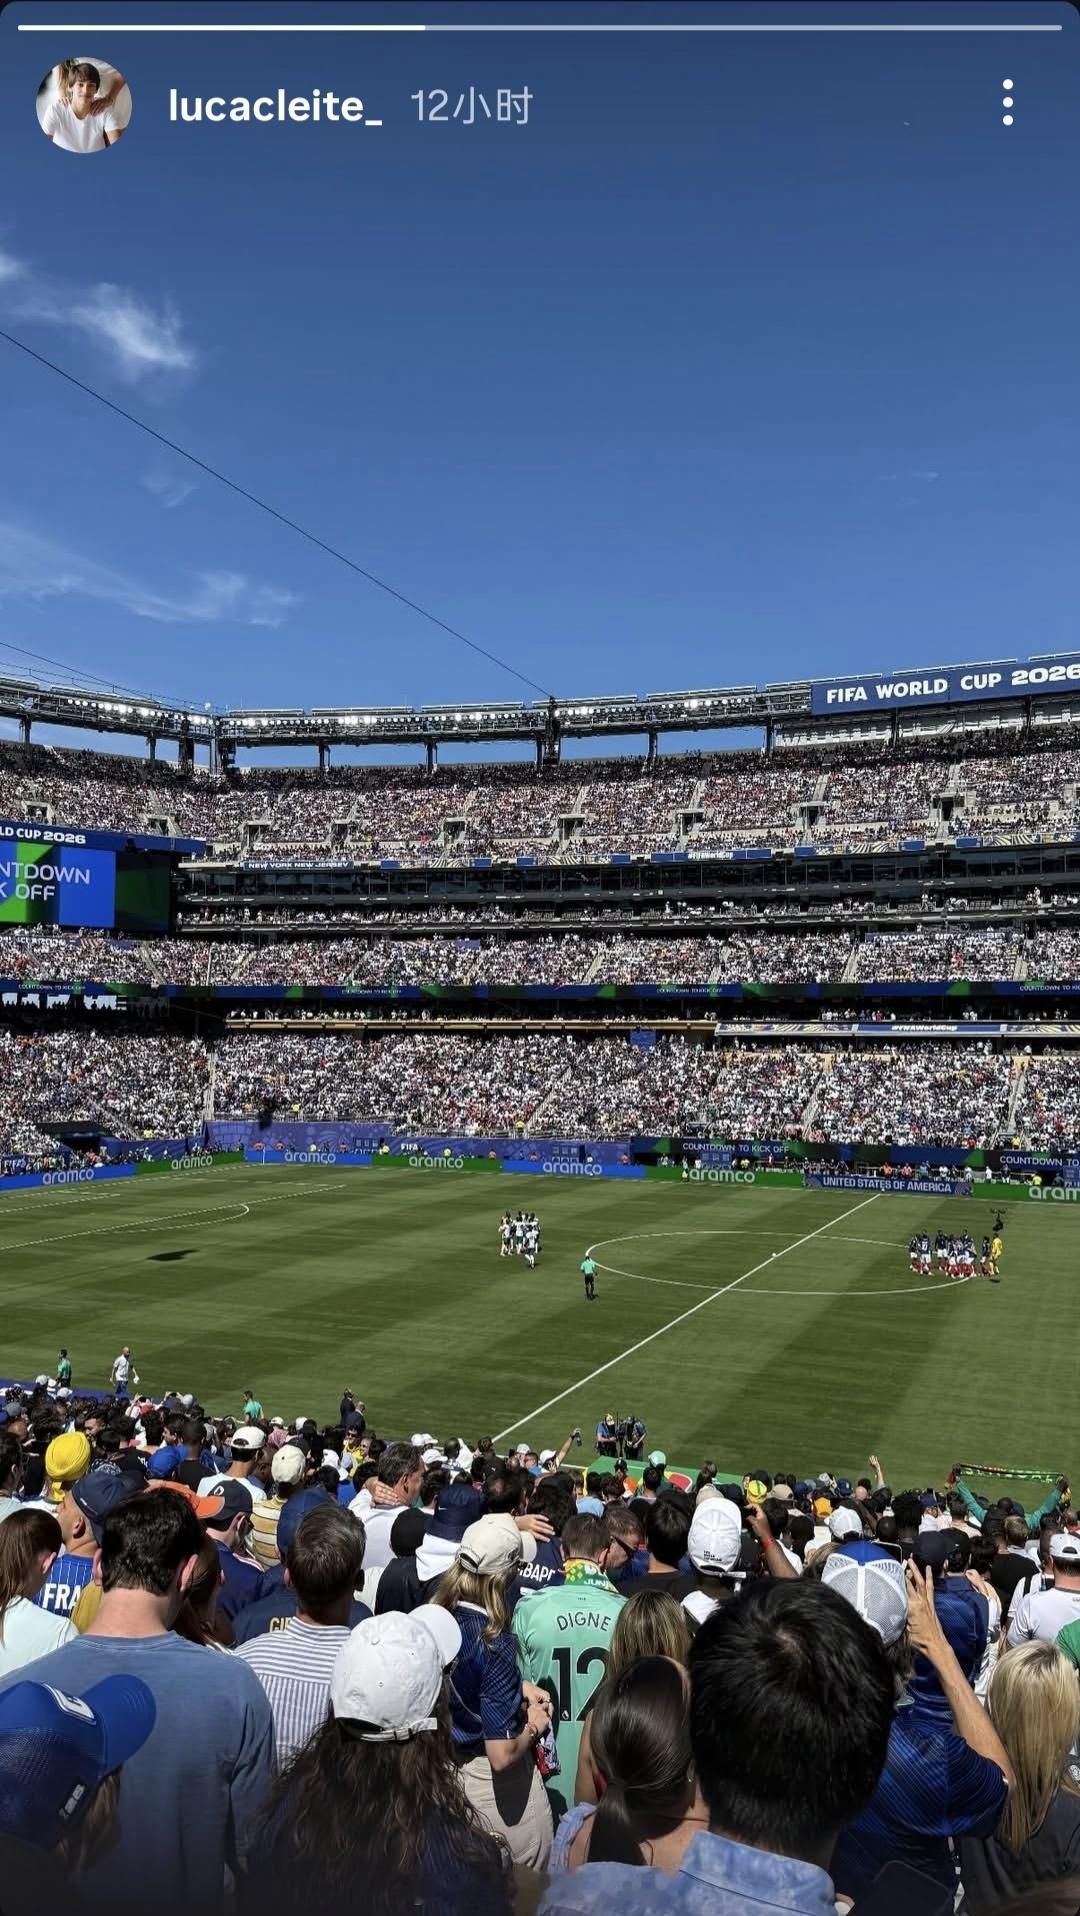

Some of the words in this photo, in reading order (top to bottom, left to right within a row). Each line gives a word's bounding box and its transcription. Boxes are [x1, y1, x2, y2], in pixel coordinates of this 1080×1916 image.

[827, 687, 867, 704] FIFA
[876, 678, 948, 700] WORLD
[960, 673, 1002, 689] CUP
[1011, 665, 1080, 686] 2026
[16, 828, 42, 839] CUP
[43, 831, 86, 844] 2026
[15, 884, 56, 901] OFF
[400, 1143, 418, 1151] FIFA
[682, 1142, 735, 1151] COUNTDOWN
[739, 1144, 749, 1152] TO
[170, 1155, 213, 1170] aramco
[284, 1151, 336, 1164] aramco
[408, 1156, 464, 1169] aramco
[1000, 1156, 1063, 1167] COUNTDOWN
[1067, 1158, 1080, 1167] TO
[543, 1161, 602, 1175] aramco
[42, 1169, 94, 1185] aramco
[689, 1169, 755, 1183] aramco
[823, 1176, 856, 1187] UNITED
[857, 1178, 891, 1190] STATES
[893, 1181, 906, 1190] OF
[907, 1182, 952, 1192] AMERICA
[1028, 1185, 1080, 1201] aram
[556, 1611, 612, 1632] DIGNE
[552, 1647, 609, 1721] 12
